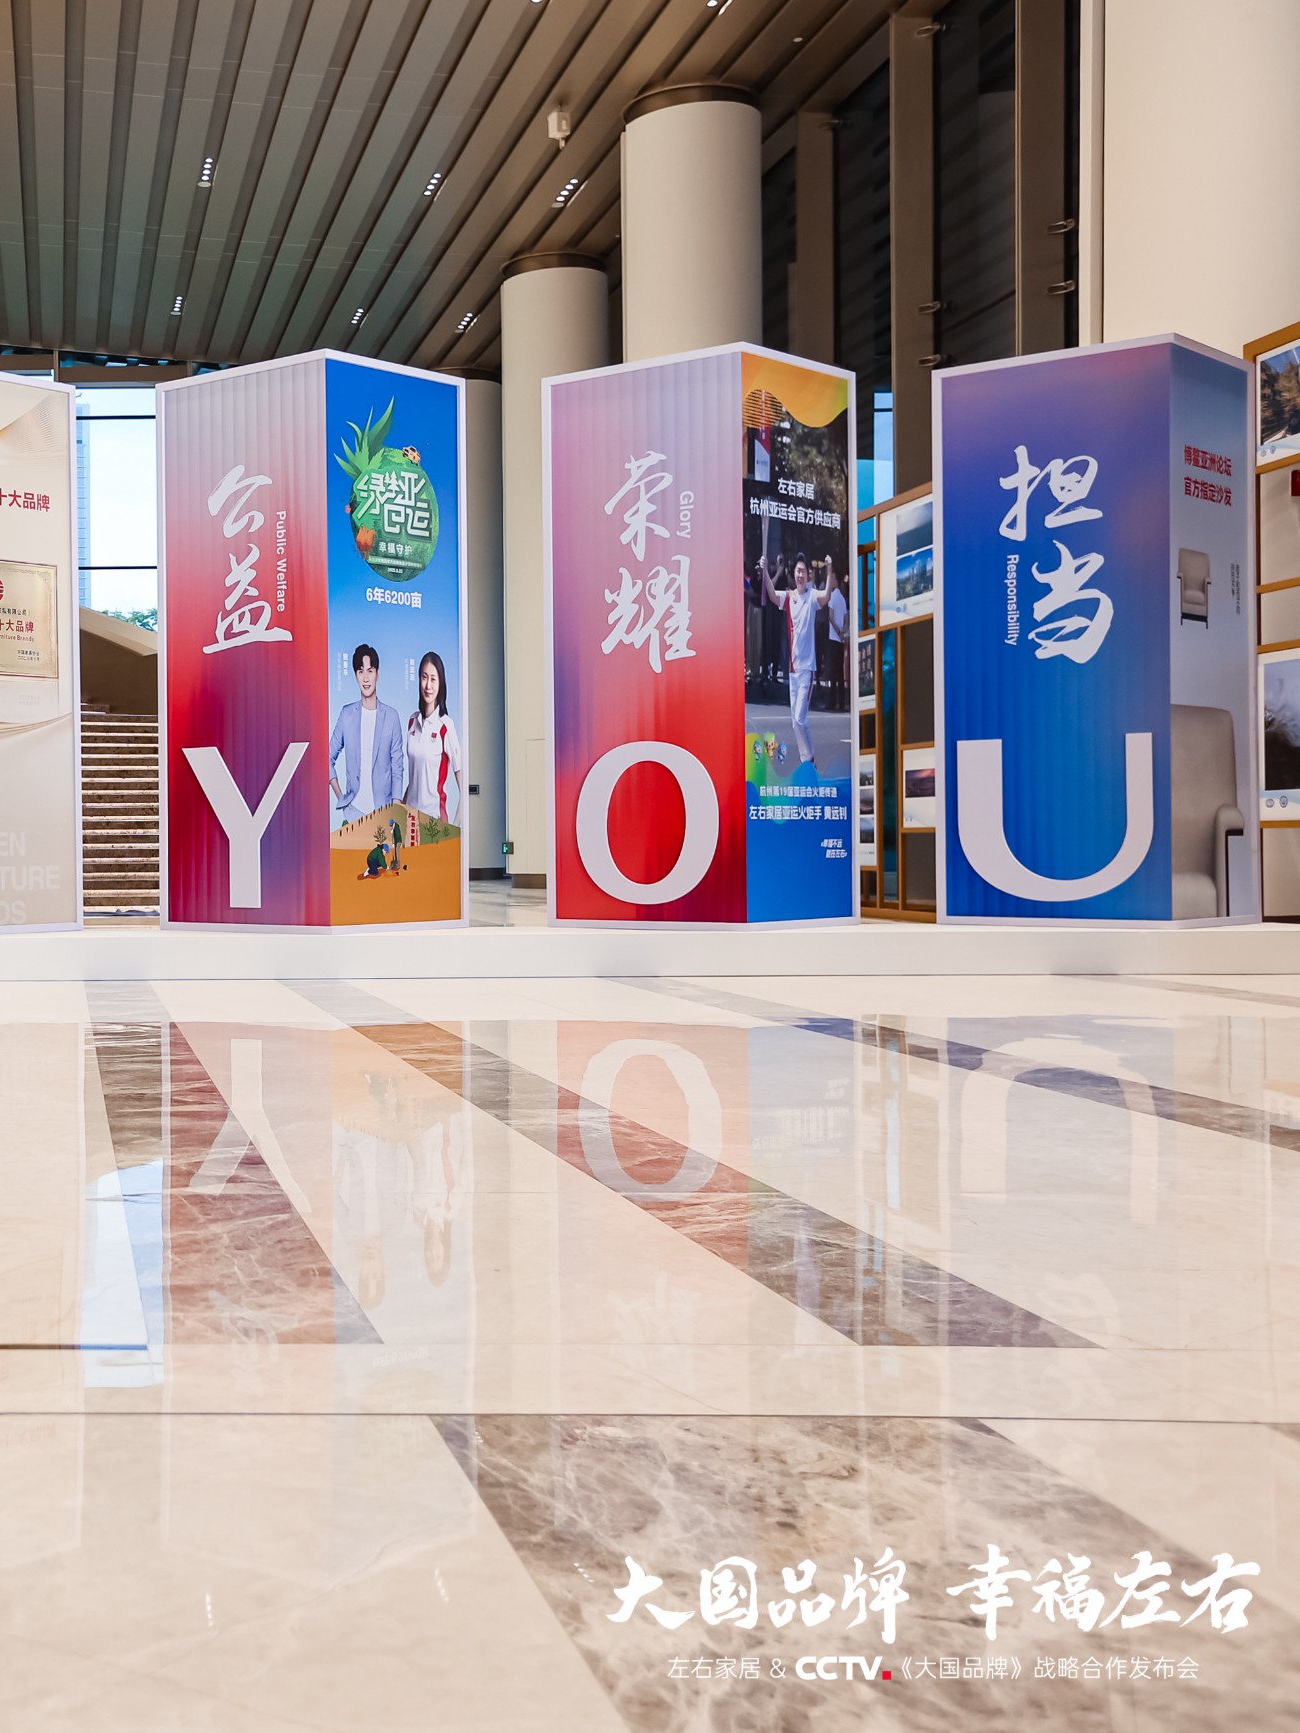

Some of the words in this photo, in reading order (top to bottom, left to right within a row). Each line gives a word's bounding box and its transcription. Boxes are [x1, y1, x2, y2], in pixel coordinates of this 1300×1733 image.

[1183, 444, 1233, 478] 博鳌亚洲论坛
[749, 496, 842, 530] 杭州亚运会官方供应商
[777, 477, 815, 501] 左右家居
[1183, 476, 1233, 507] 官方指定沙发
[275, 509, 287, 555] Public
[675, 490, 695, 539] Glory
[202, 464, 293, 655] 公益
[600, 450, 697, 674] 荣耀
[998, 444, 1115, 665] 担当
[276, 557, 287, 613] Welfare
[365, 586, 423, 609] 6年6200亩
[1004, 554, 1019, 646] Responsibility
[16, 634, 35, 642] Brands
[181, 741, 310, 909] Y
[575, 740, 720, 905] O
[748, 805, 822, 821] 左右家居亚运火炬手
[956, 732, 1155, 903] U
